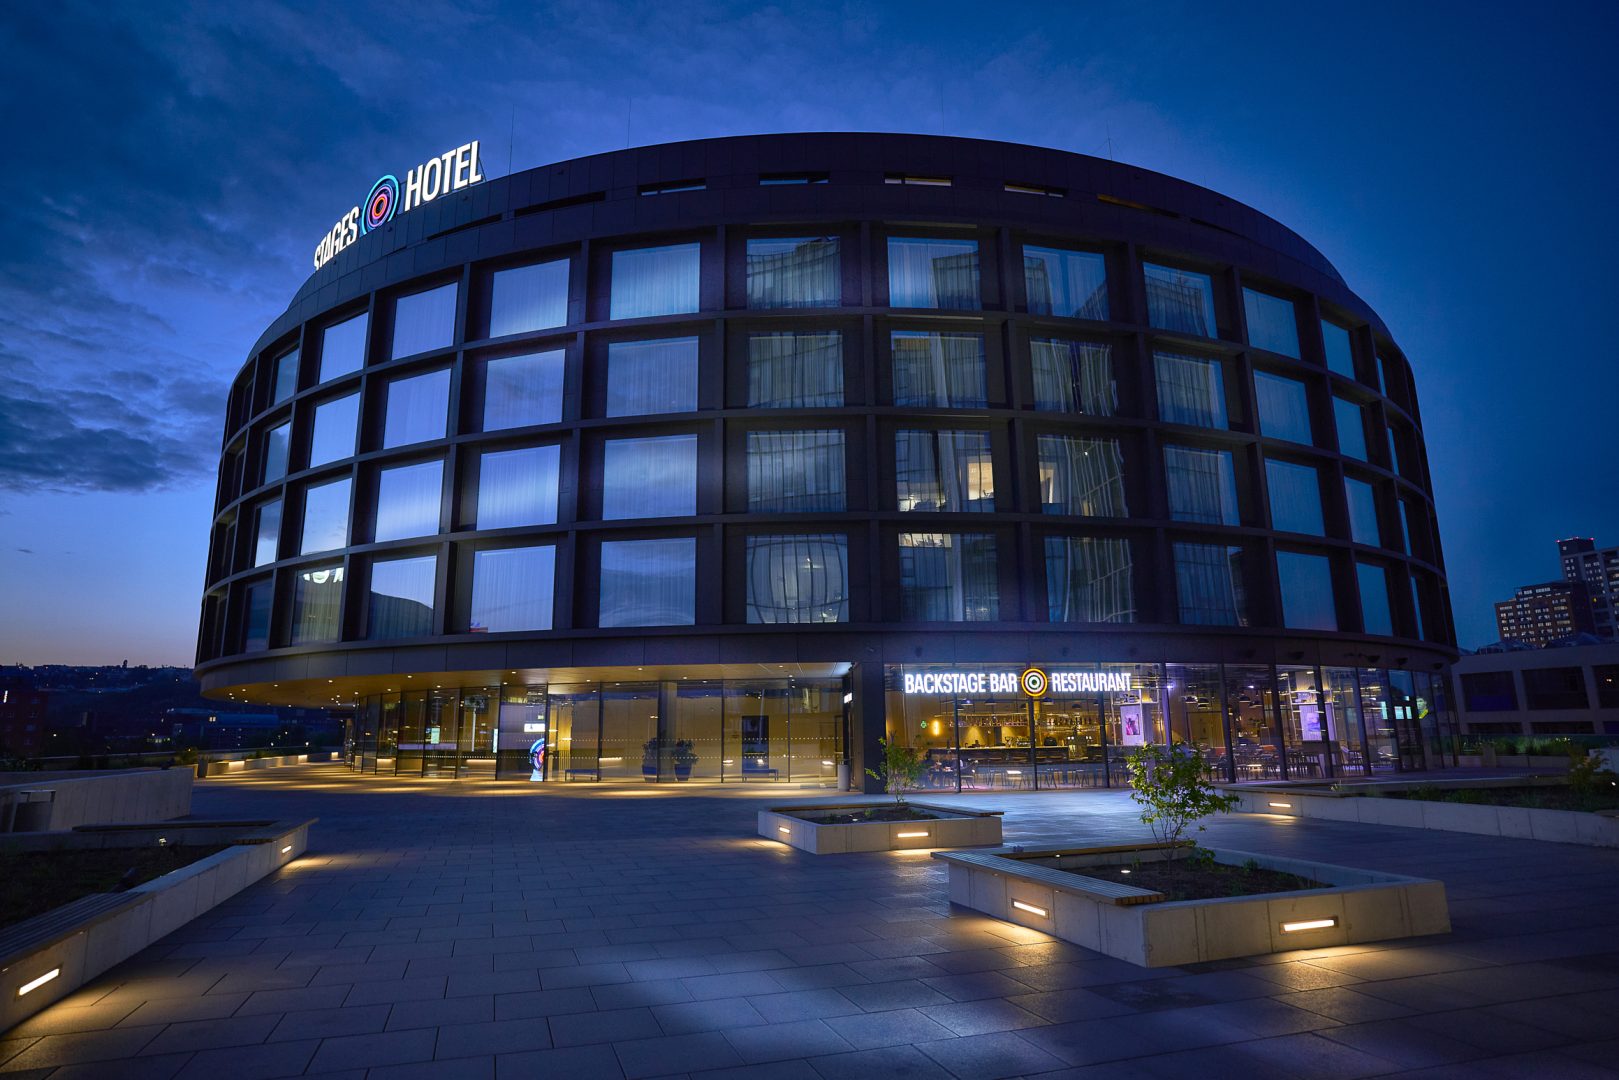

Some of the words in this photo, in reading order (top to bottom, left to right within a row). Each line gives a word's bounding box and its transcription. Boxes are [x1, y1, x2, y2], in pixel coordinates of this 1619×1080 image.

[314, 206, 359, 270] STAGES
[404, 140, 482, 212] HOTEL
[904, 673, 986, 694] BACKSTAGE
[990, 673, 1018, 693] BAR
[1052, 672, 1132, 693] RESTAURANT
